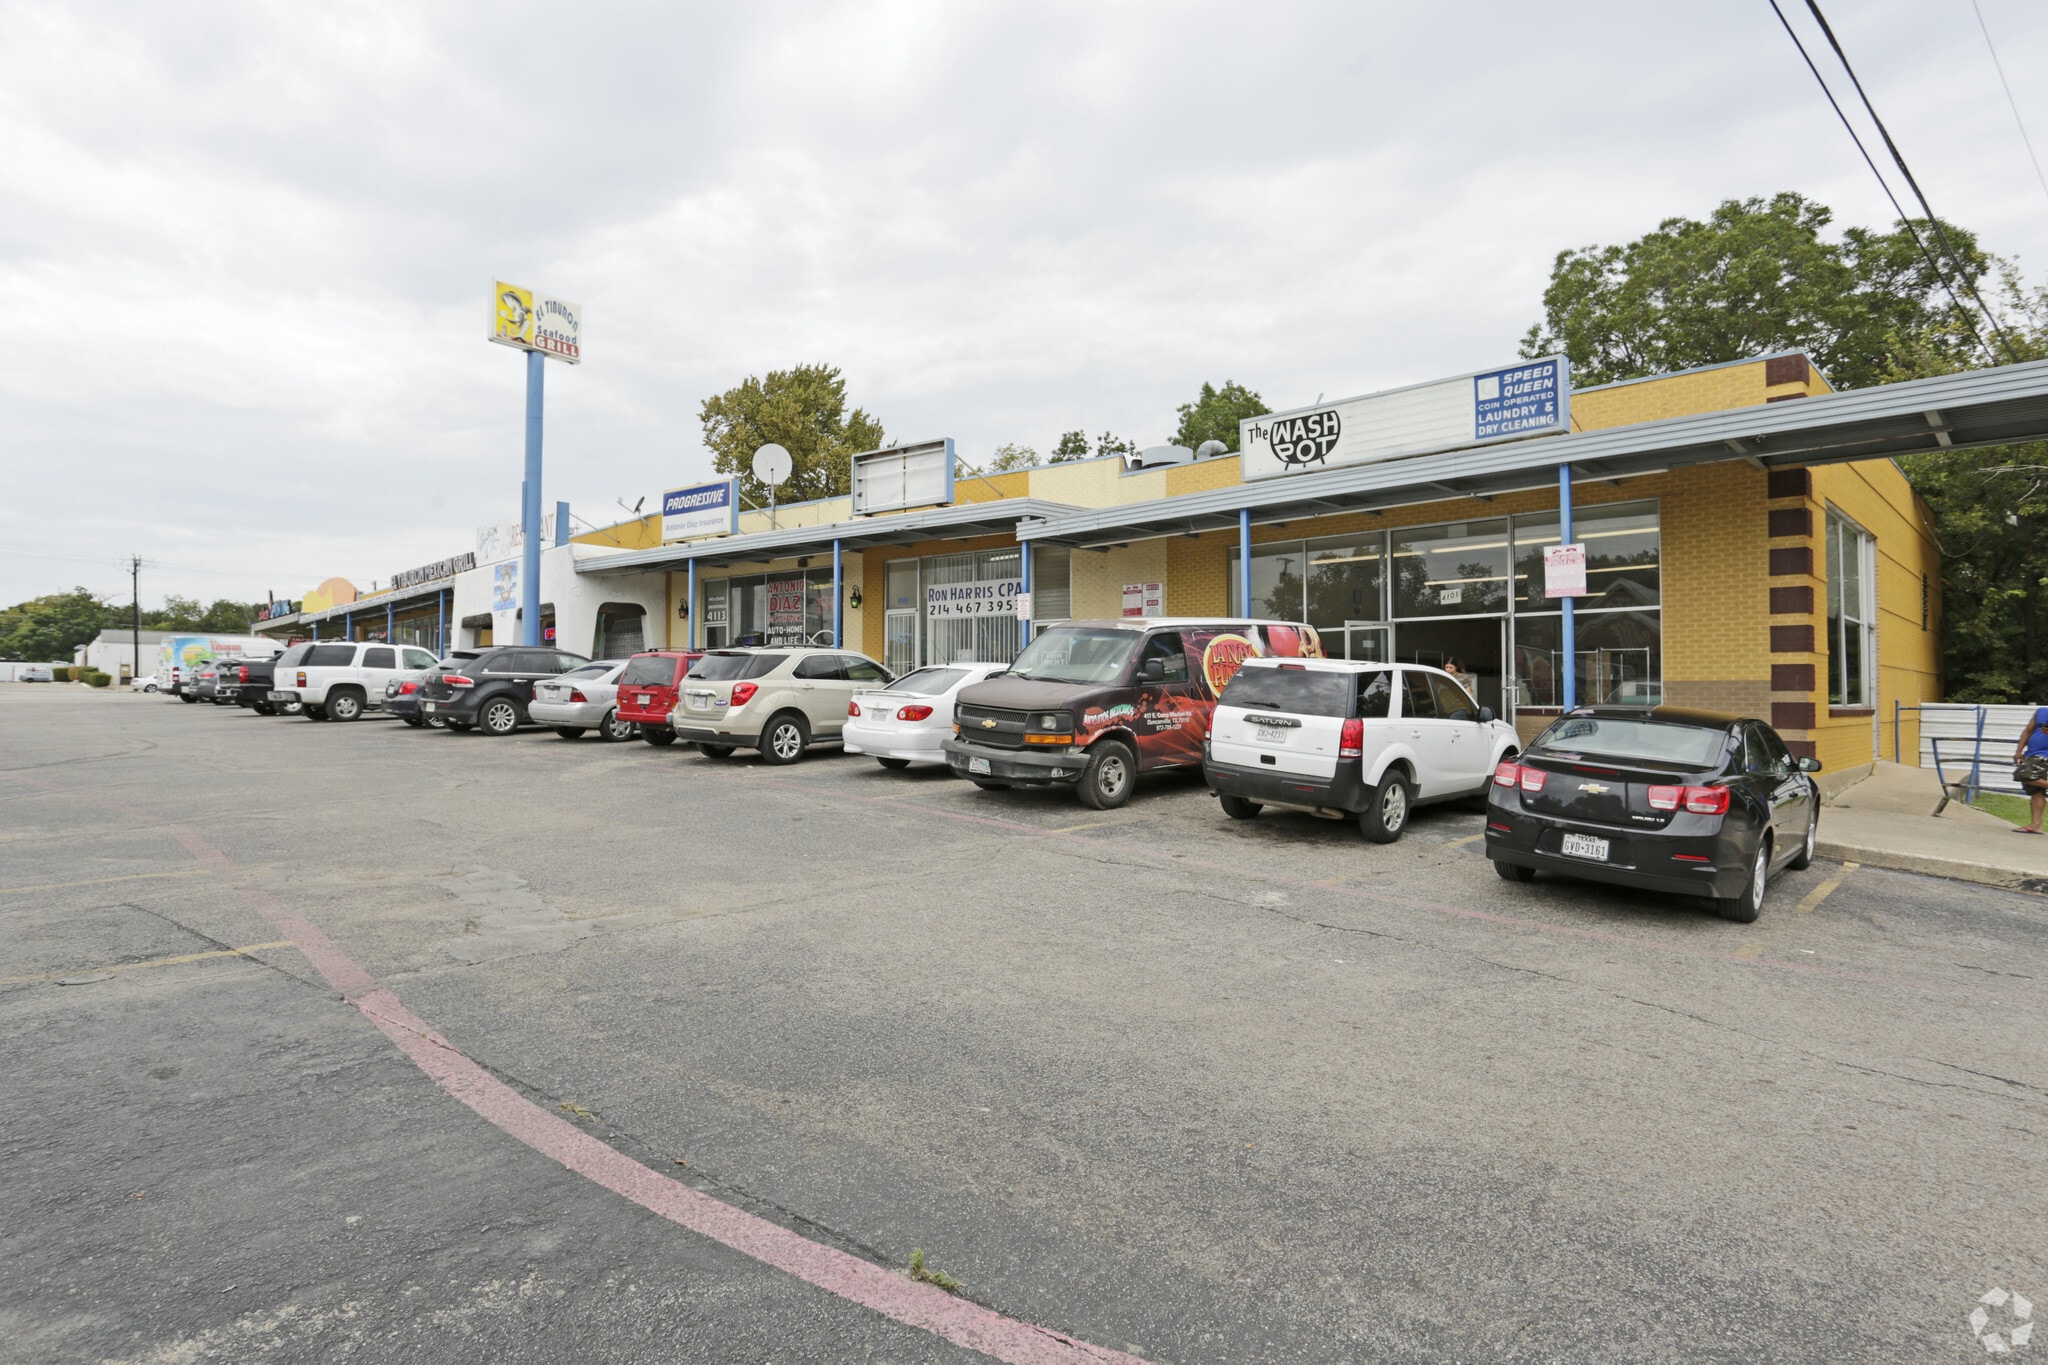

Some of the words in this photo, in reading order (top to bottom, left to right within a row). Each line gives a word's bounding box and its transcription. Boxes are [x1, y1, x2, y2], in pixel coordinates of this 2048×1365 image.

[537, 325, 577, 345] Seafood
[536, 335, 578, 357] GRILL
[1503, 365, 1553, 384] SPEED
[1503, 378, 1554, 397] QUEEN
[1478, 401, 1500, 411] COIN
[1503, 391, 1554, 407] OPERATED
[1478, 404, 1537, 424] LAUNDRY
[1544, 401, 1554, 412] &
[1248, 422, 1269, 444] The
[1272, 412, 1339, 445] WASH
[1478, 423, 1499, 436] DRY
[1501, 414, 1555, 432] CLEANING
[1273, 434, 1338, 461] POT
[665, 488, 726, 511] PROGRESSIVE
[665, 522, 687, 532] Antonio
[686, 520, 698, 529] Diaz
[699, 517, 725, 526] Insurance
[399, 564, 424, 588] TIBURON
[424, 558, 451, 582] MEXICAN
[453, 552, 475, 573] GRILL
[767, 579, 805, 594] ANTONIO
[928, 588, 948, 602] RON
[950, 586, 994, 601] HARRIS
[998, 581, 1022, 598] CPA
[1441, 591, 1459, 601] 4101
[769, 595, 802, 612] DIAZ
[929, 604, 950, 616] 214
[956, 602, 981, 614] 467
[987, 599, 1018, 612] 395
[707, 610, 726, 621] 4113
[767, 625, 804, 635] AUTO-HOME
[770, 637, 783, 646] AND
[784, 636, 799, 645] LIFE
[1251, 716, 1292, 726] SATURN
[1564, 840, 1606, 857] GVD-3161
